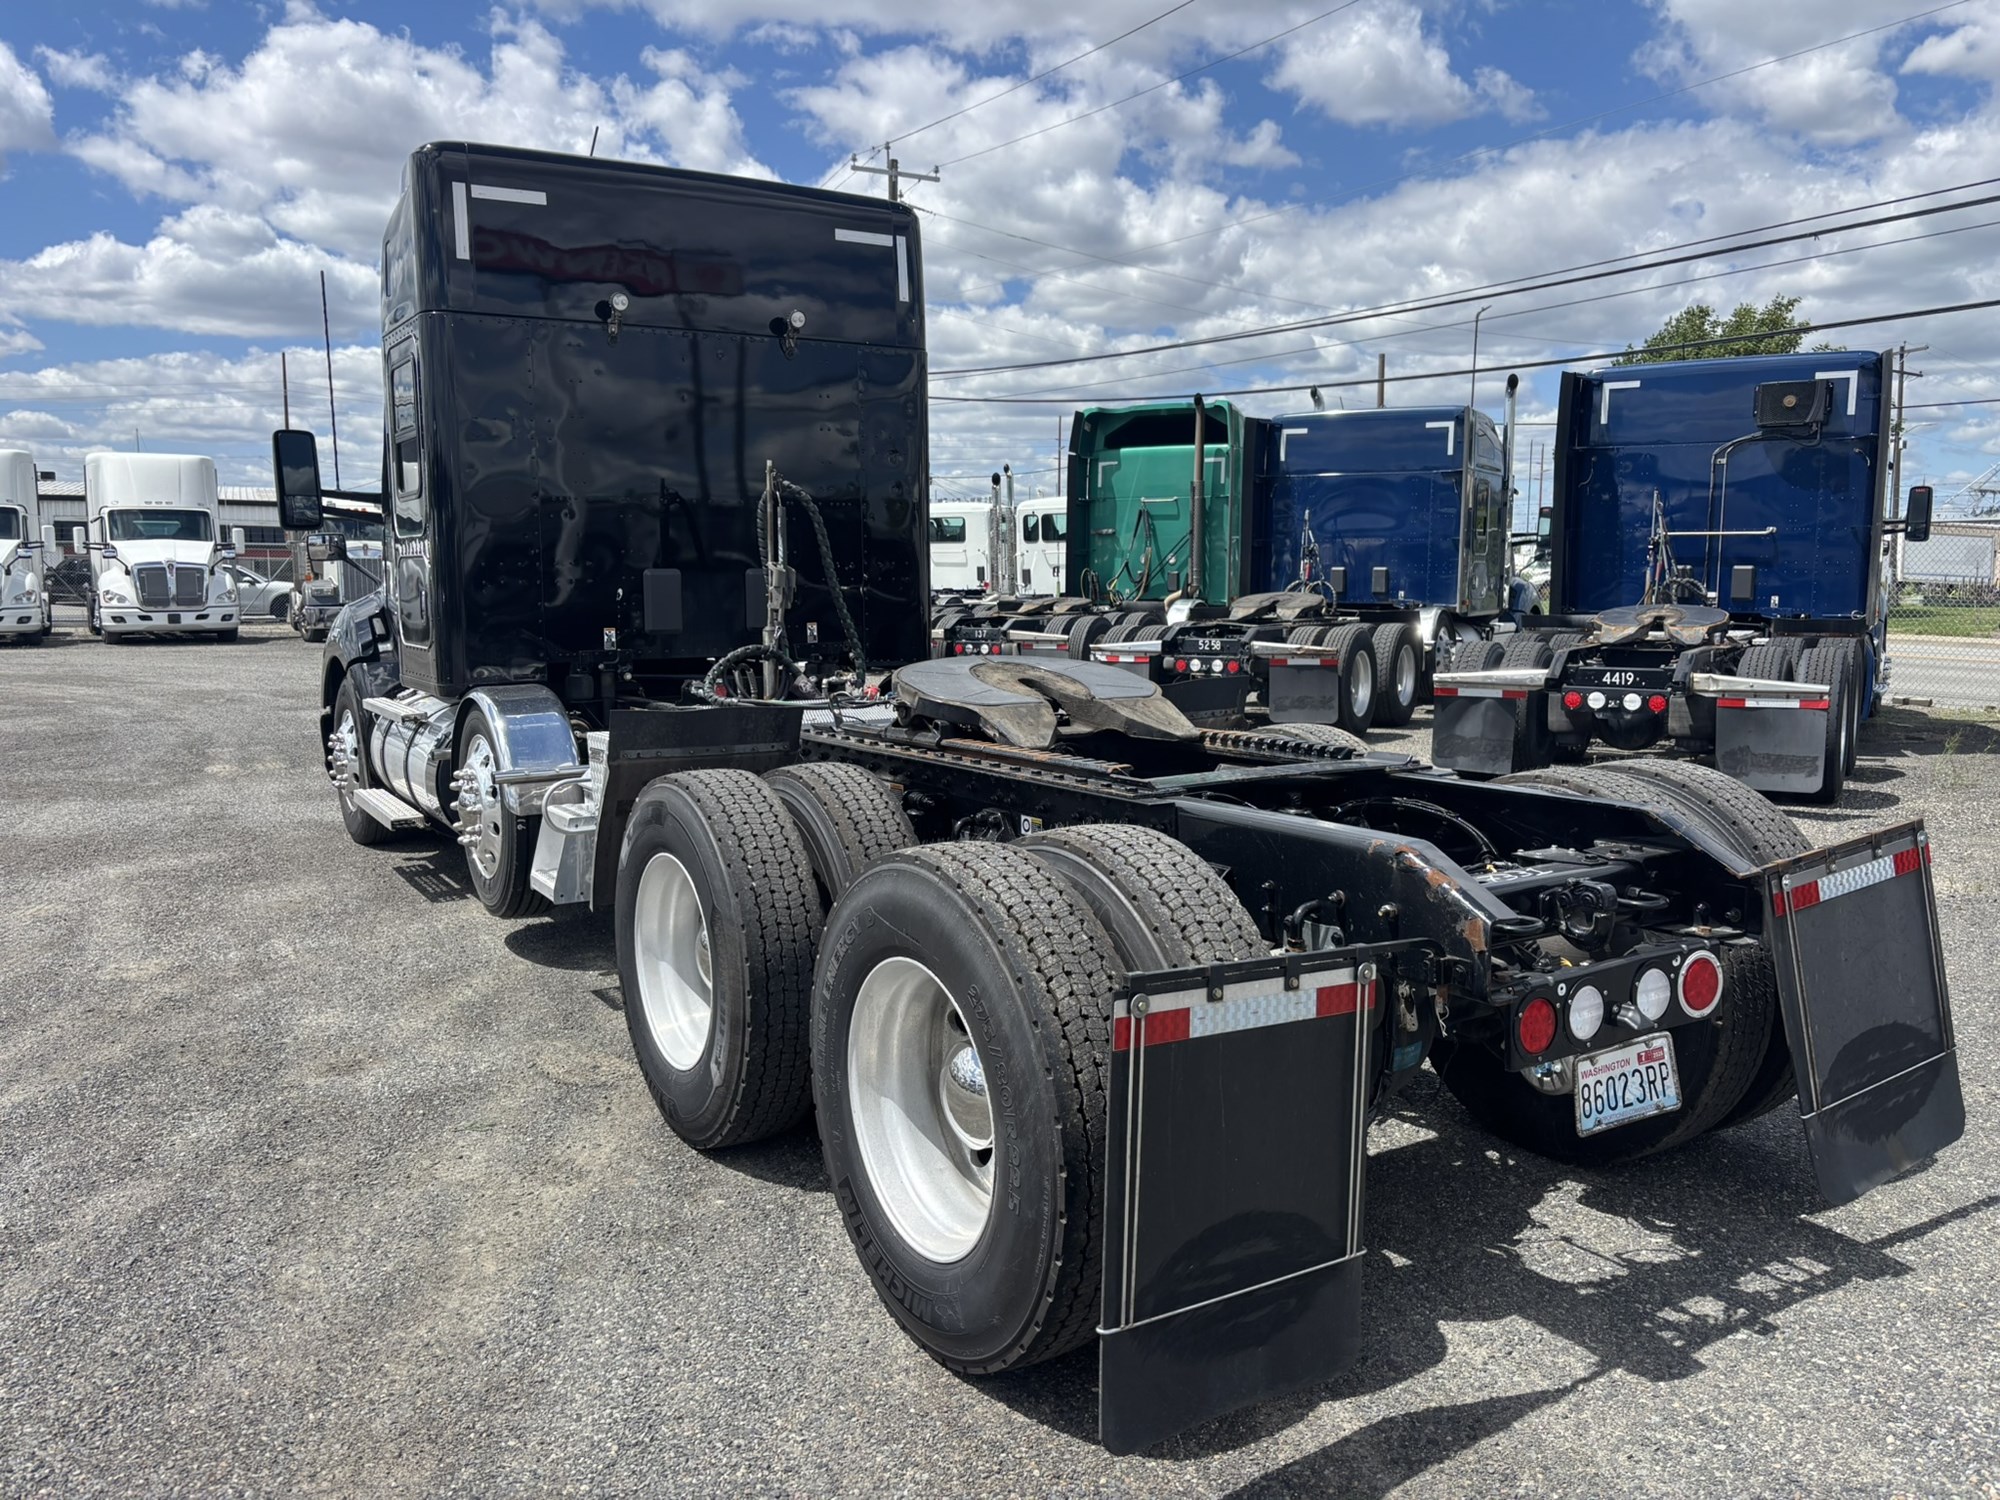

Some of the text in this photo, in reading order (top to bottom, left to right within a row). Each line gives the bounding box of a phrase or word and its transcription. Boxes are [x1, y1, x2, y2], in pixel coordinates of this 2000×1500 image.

[1602, 672, 1634, 685] 4419
[814, 1001, 829, 1068] LINE
[822, 916, 862, 1000] ENERGY
[1580, 1058, 1631, 1080] WASHINGTON
[1581, 1062, 1669, 1119] 86023RP
[840, 1187, 932, 1323] MICHELIN
